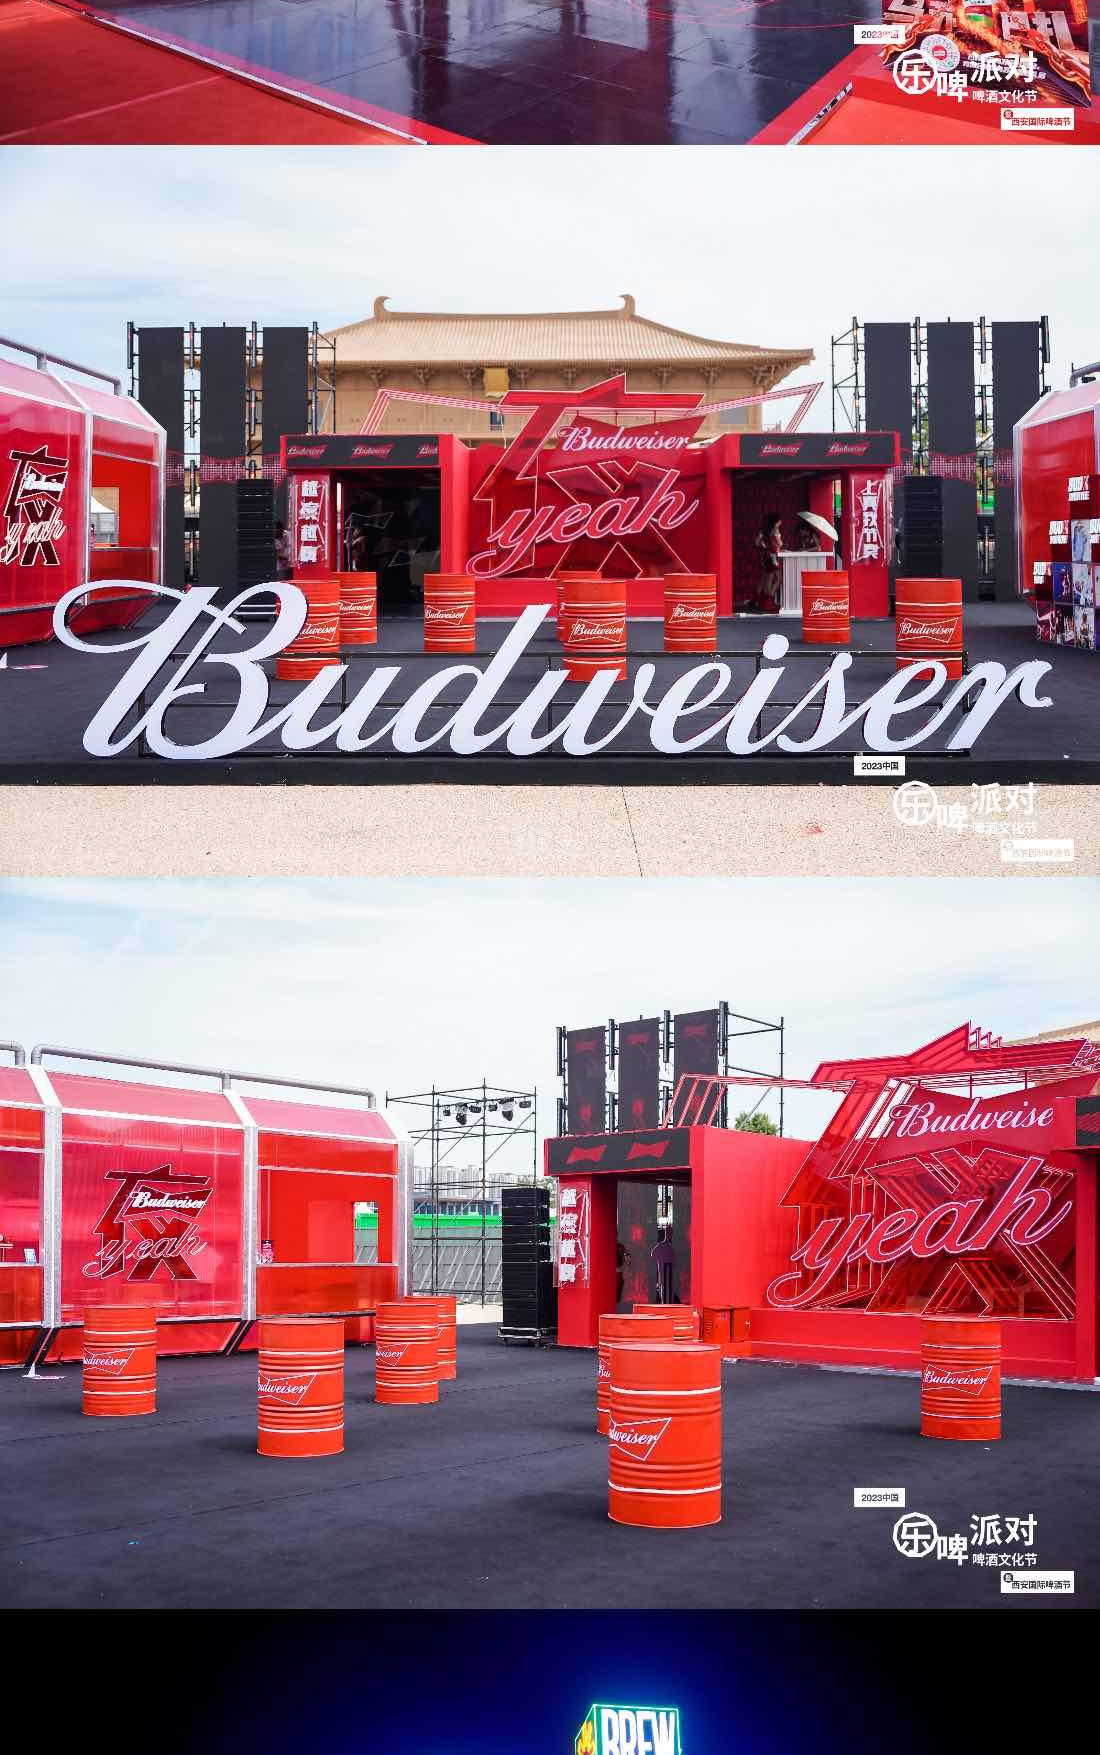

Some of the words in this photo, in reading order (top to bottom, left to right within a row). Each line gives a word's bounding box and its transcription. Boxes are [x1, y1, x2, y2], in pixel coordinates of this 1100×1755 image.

[555, 424, 694, 452] Budweiser
[466, 469, 700, 579] yeah
[571, 621, 624, 638] Budweiser
[900, 619, 955, 637] Budweiser
[53, 579, 1053, 761] Budweiser
[889, 1097, 1054, 1138] Budweise
[131, 1191, 207, 1210] Budweiser
[767, 1156, 1073, 1308] yeah
[82, 1224, 208, 1279] yeah
[924, 1369, 988, 1386] Budweiser
